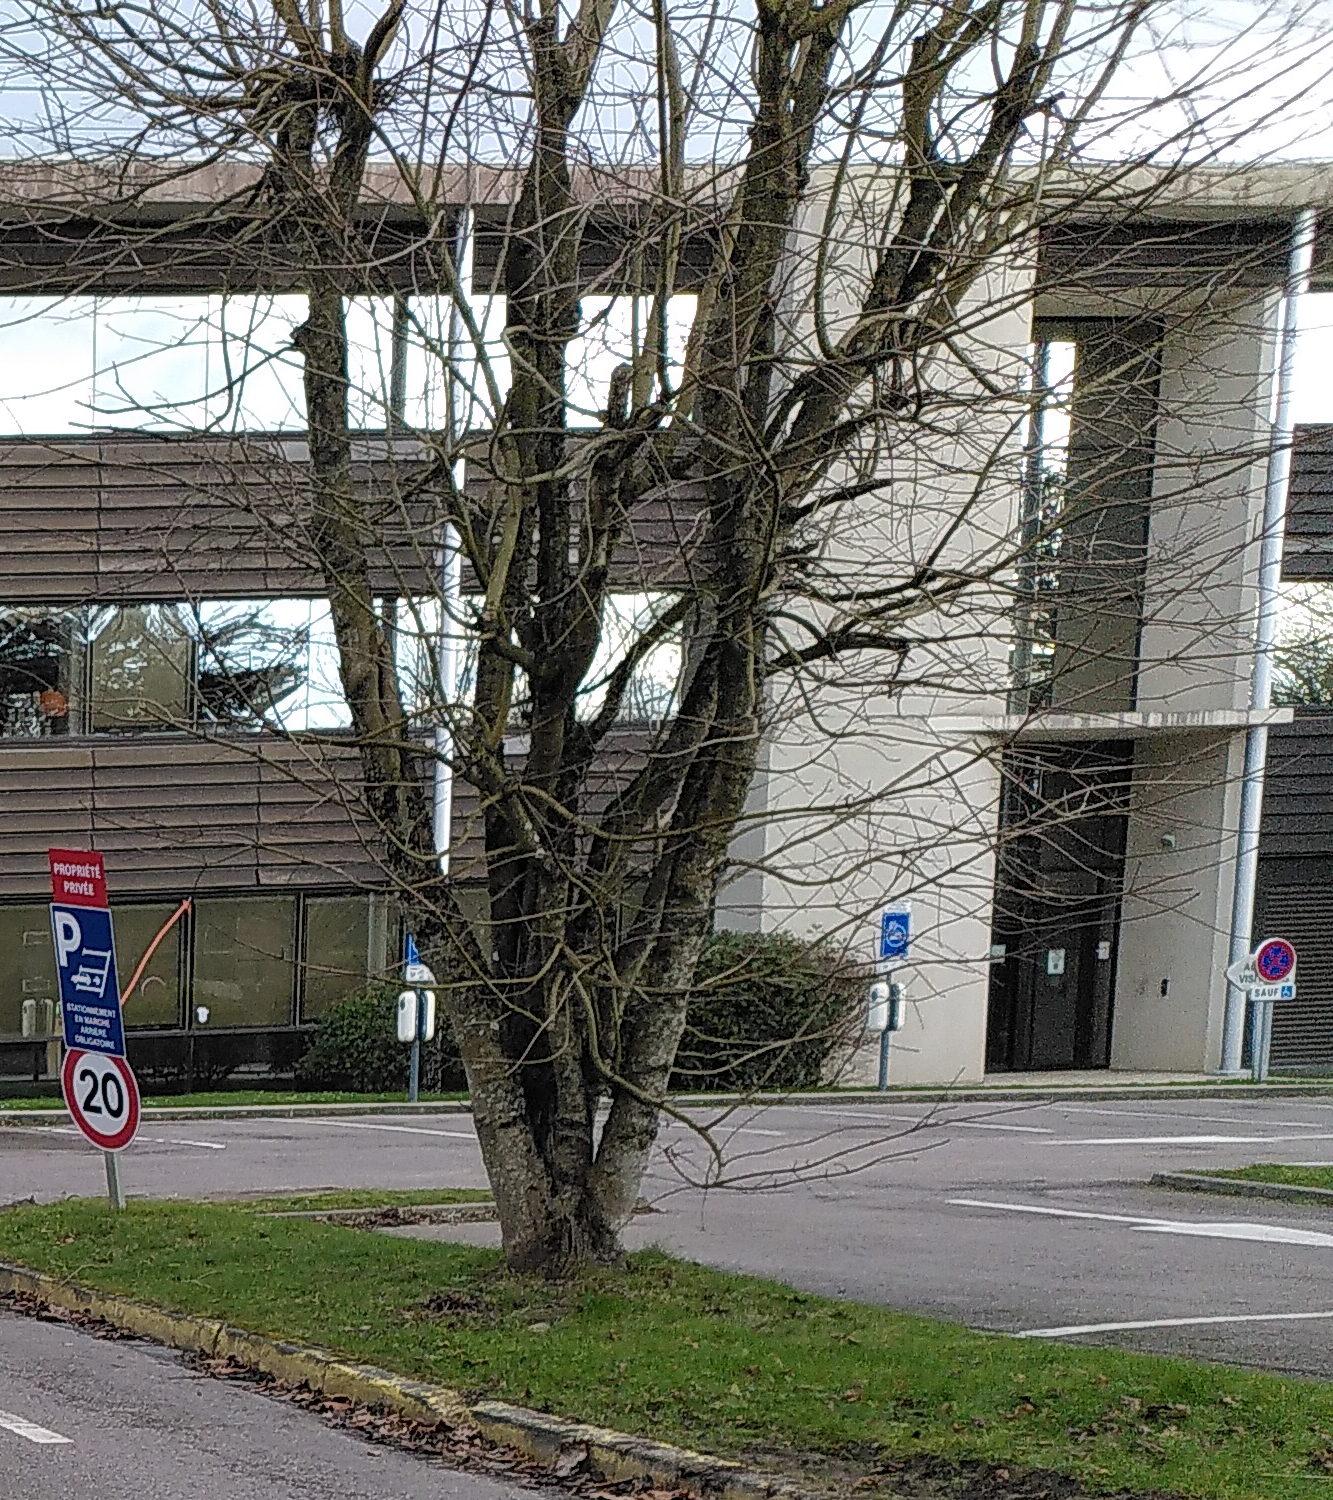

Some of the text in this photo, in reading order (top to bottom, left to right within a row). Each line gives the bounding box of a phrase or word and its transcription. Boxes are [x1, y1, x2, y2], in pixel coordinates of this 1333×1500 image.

[53, 862, 101, 879] PROPRIÉTÉ
[64, 880, 95, 896] PRIVÉE
[54, 911, 81, 967] P
[1254, 988, 1279, 997] SAUF
[79, 1068, 124, 1118] 20
